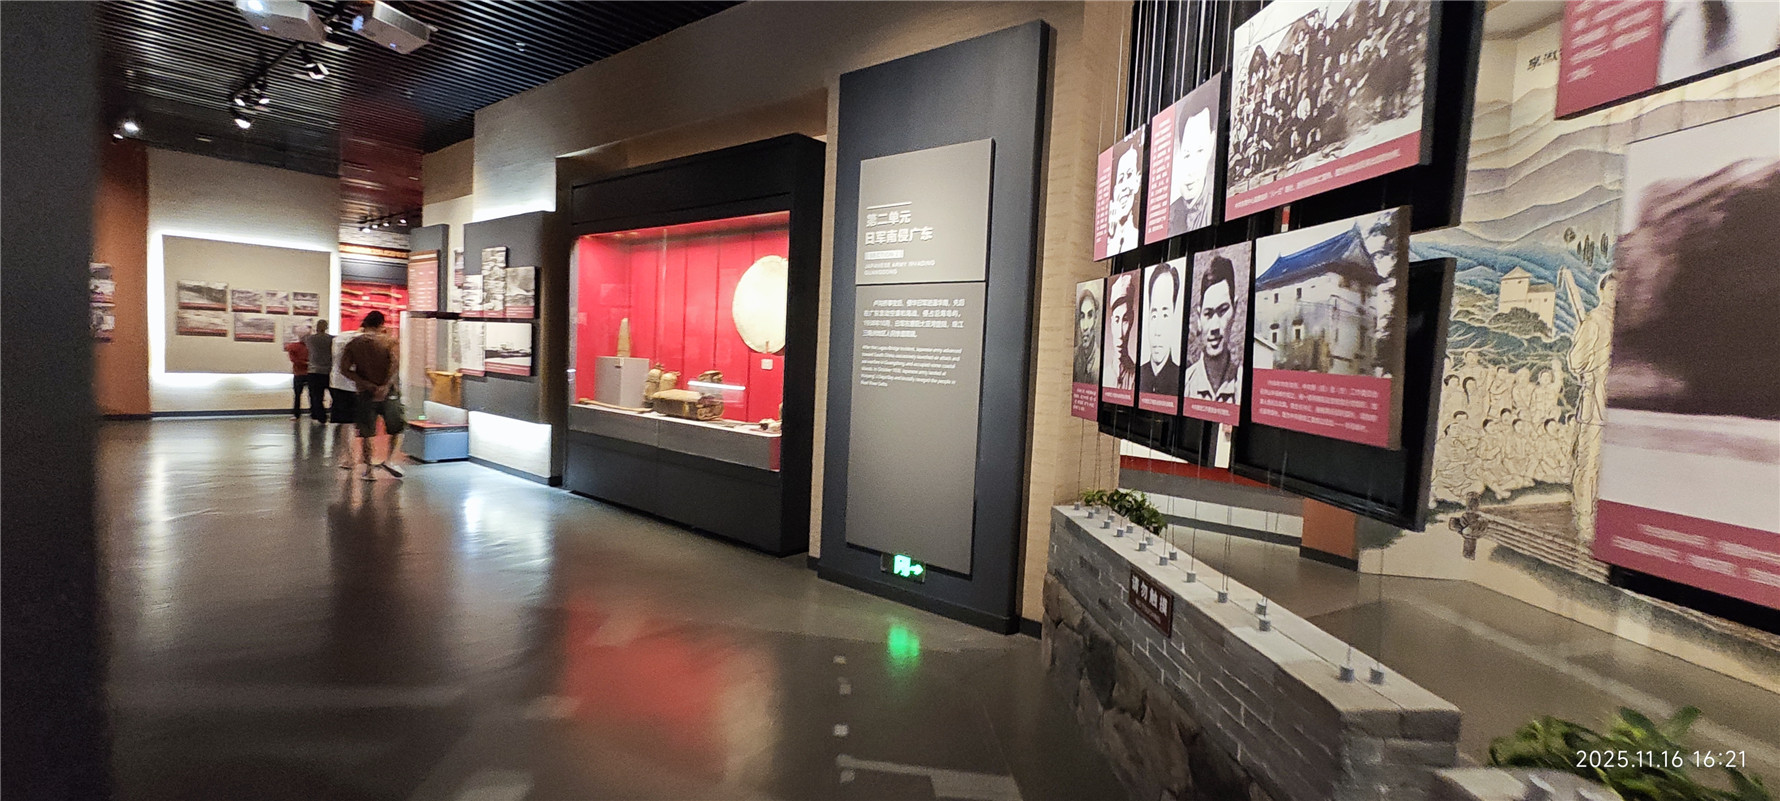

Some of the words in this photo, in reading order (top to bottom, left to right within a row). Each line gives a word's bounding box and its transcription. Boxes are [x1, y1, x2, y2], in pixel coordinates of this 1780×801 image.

[866, 210, 912, 227] 第二单元
[865, 226, 934, 246] 日军南侵广东
[1132, 574, 1168, 617] 请勿触摸
